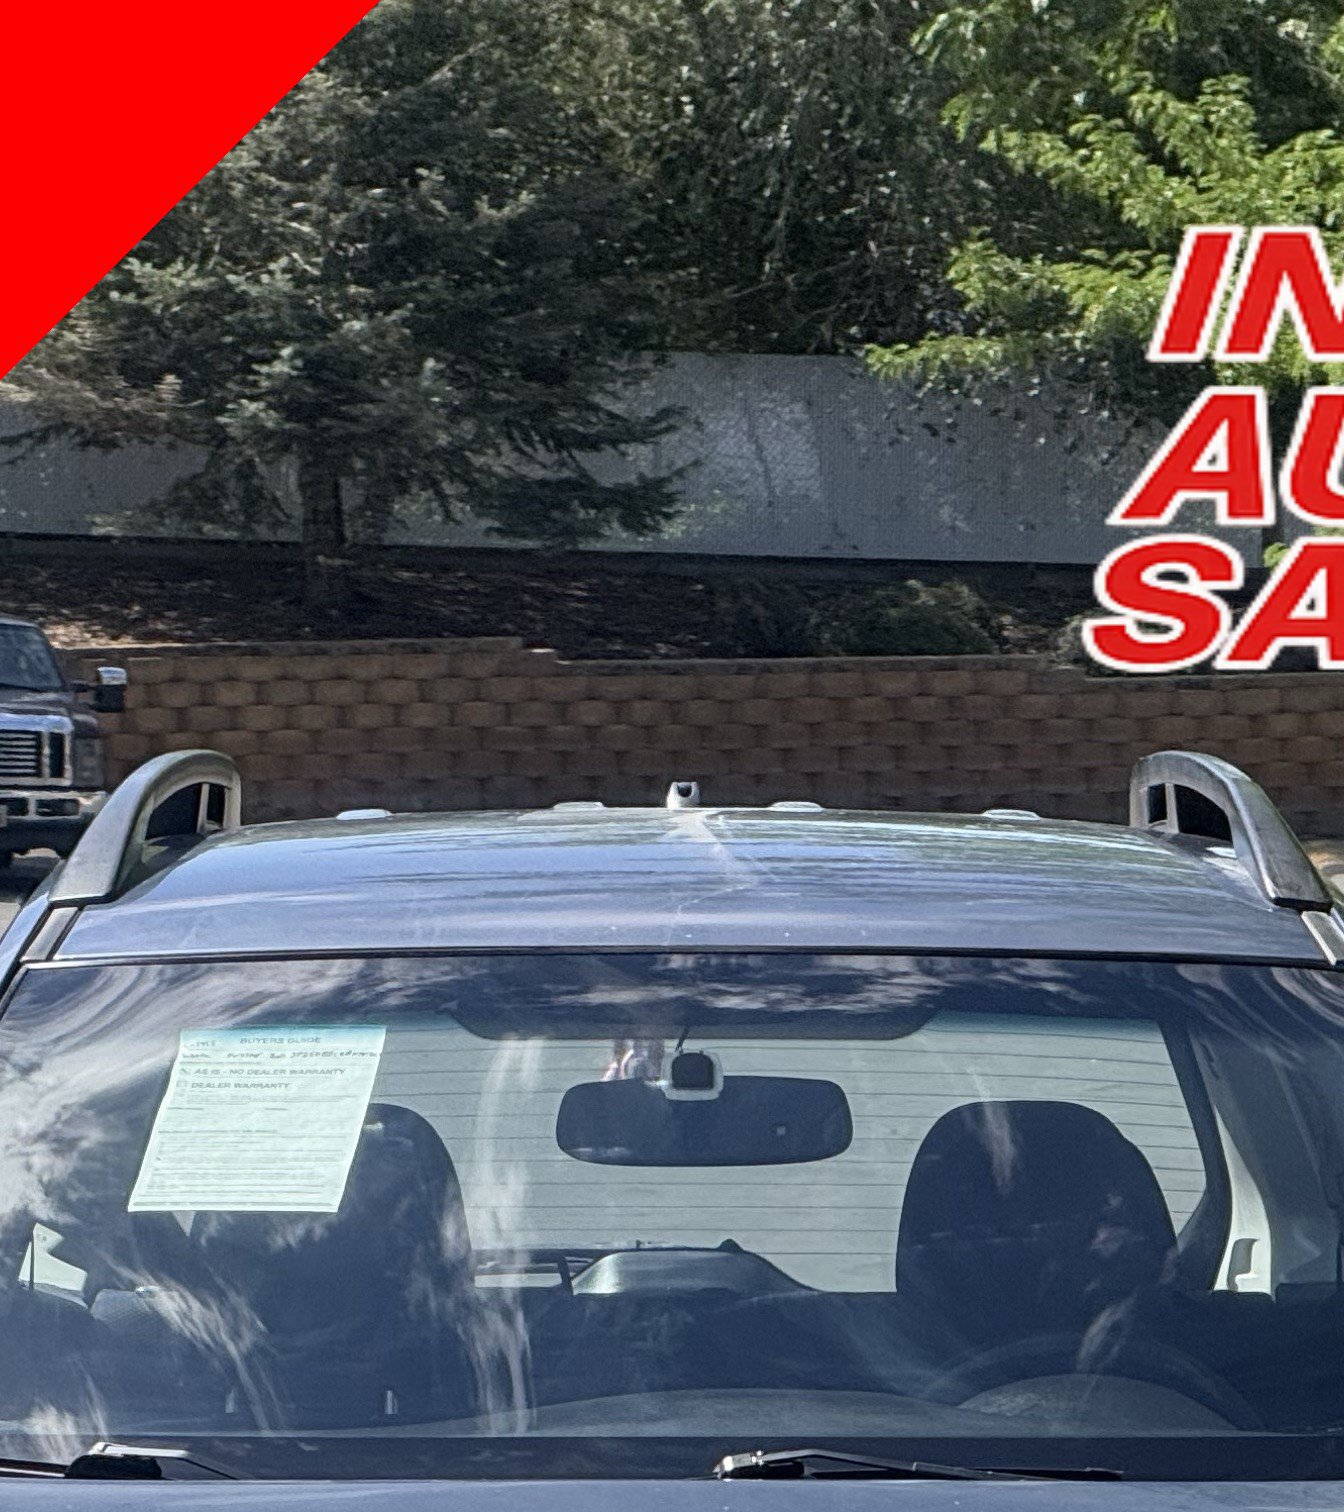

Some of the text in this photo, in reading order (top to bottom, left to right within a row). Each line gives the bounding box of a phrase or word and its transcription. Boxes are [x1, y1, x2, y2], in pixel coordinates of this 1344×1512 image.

[229, 1068, 244, 1076] NO
[246, 1068, 286, 1076] DEALER
[289, 1067, 346, 1076] WARRANTY
